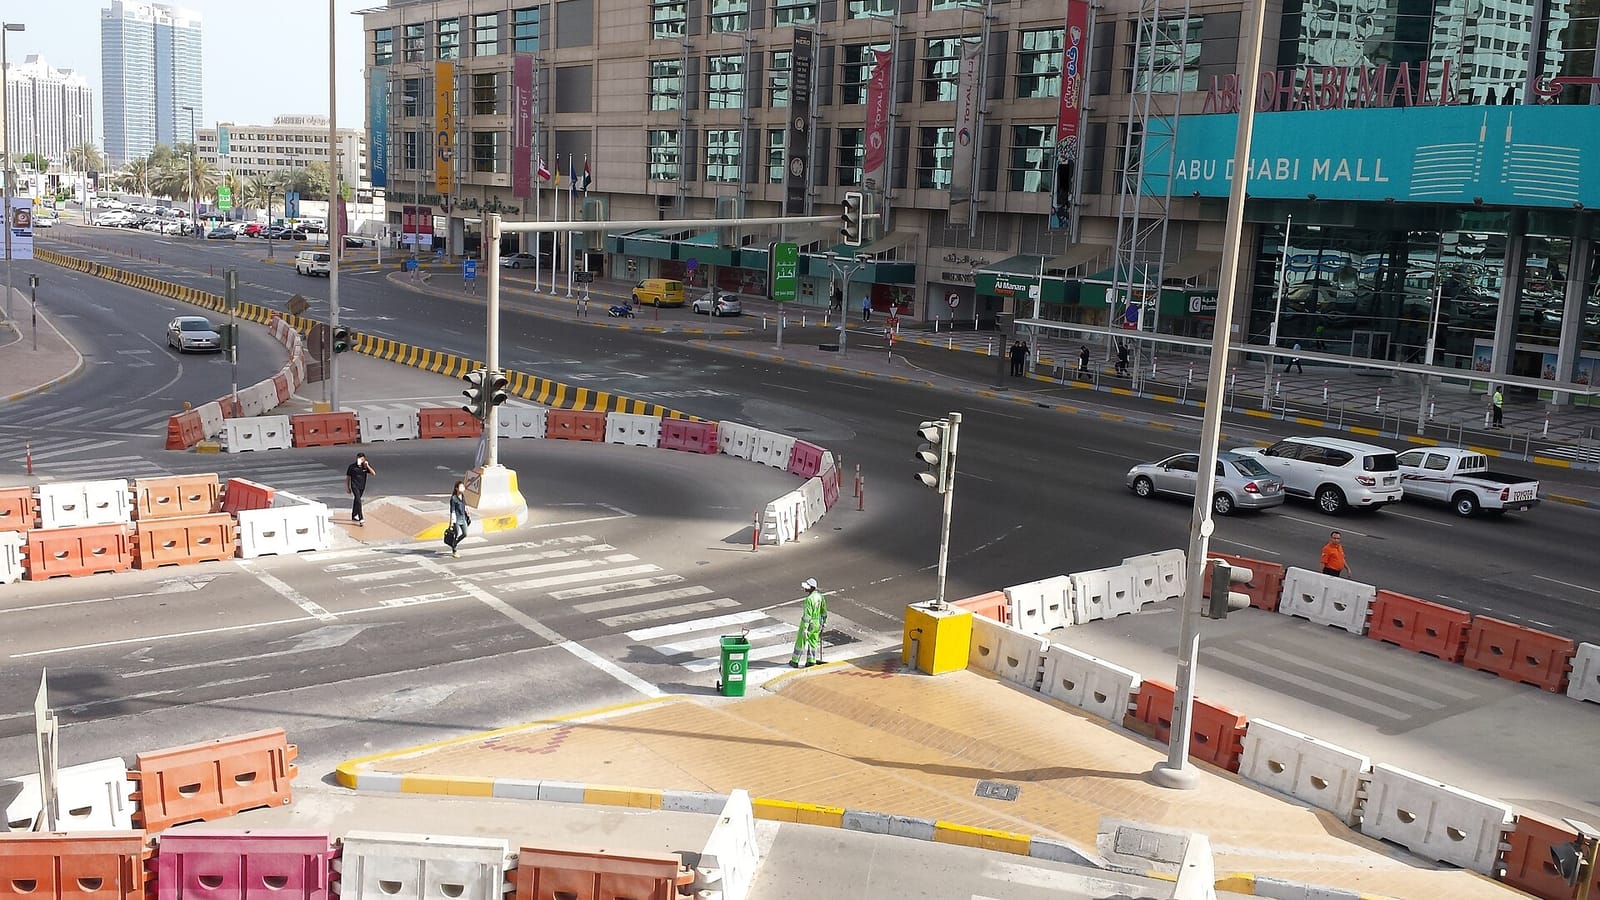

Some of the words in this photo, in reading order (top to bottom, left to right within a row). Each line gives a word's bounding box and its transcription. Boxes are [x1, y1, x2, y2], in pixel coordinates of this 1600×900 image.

[1256, 66, 1348, 112] DHABI
[1354, 60, 1461, 107] MALL
[874, 93, 883, 128] TOTAL
[963, 86, 974, 123] TOTAL
[1176, 159, 1216, 181] ABU
[1225, 158, 1300, 181] DHABI
[1311, 158, 1390, 182] MALL
[776, 267, 796, 280] أكثر
[995, 281, 1003, 289] Al
[1003, 282, 1026, 291] Manara
[1513, 489, 1534, 502] TOYOTA
